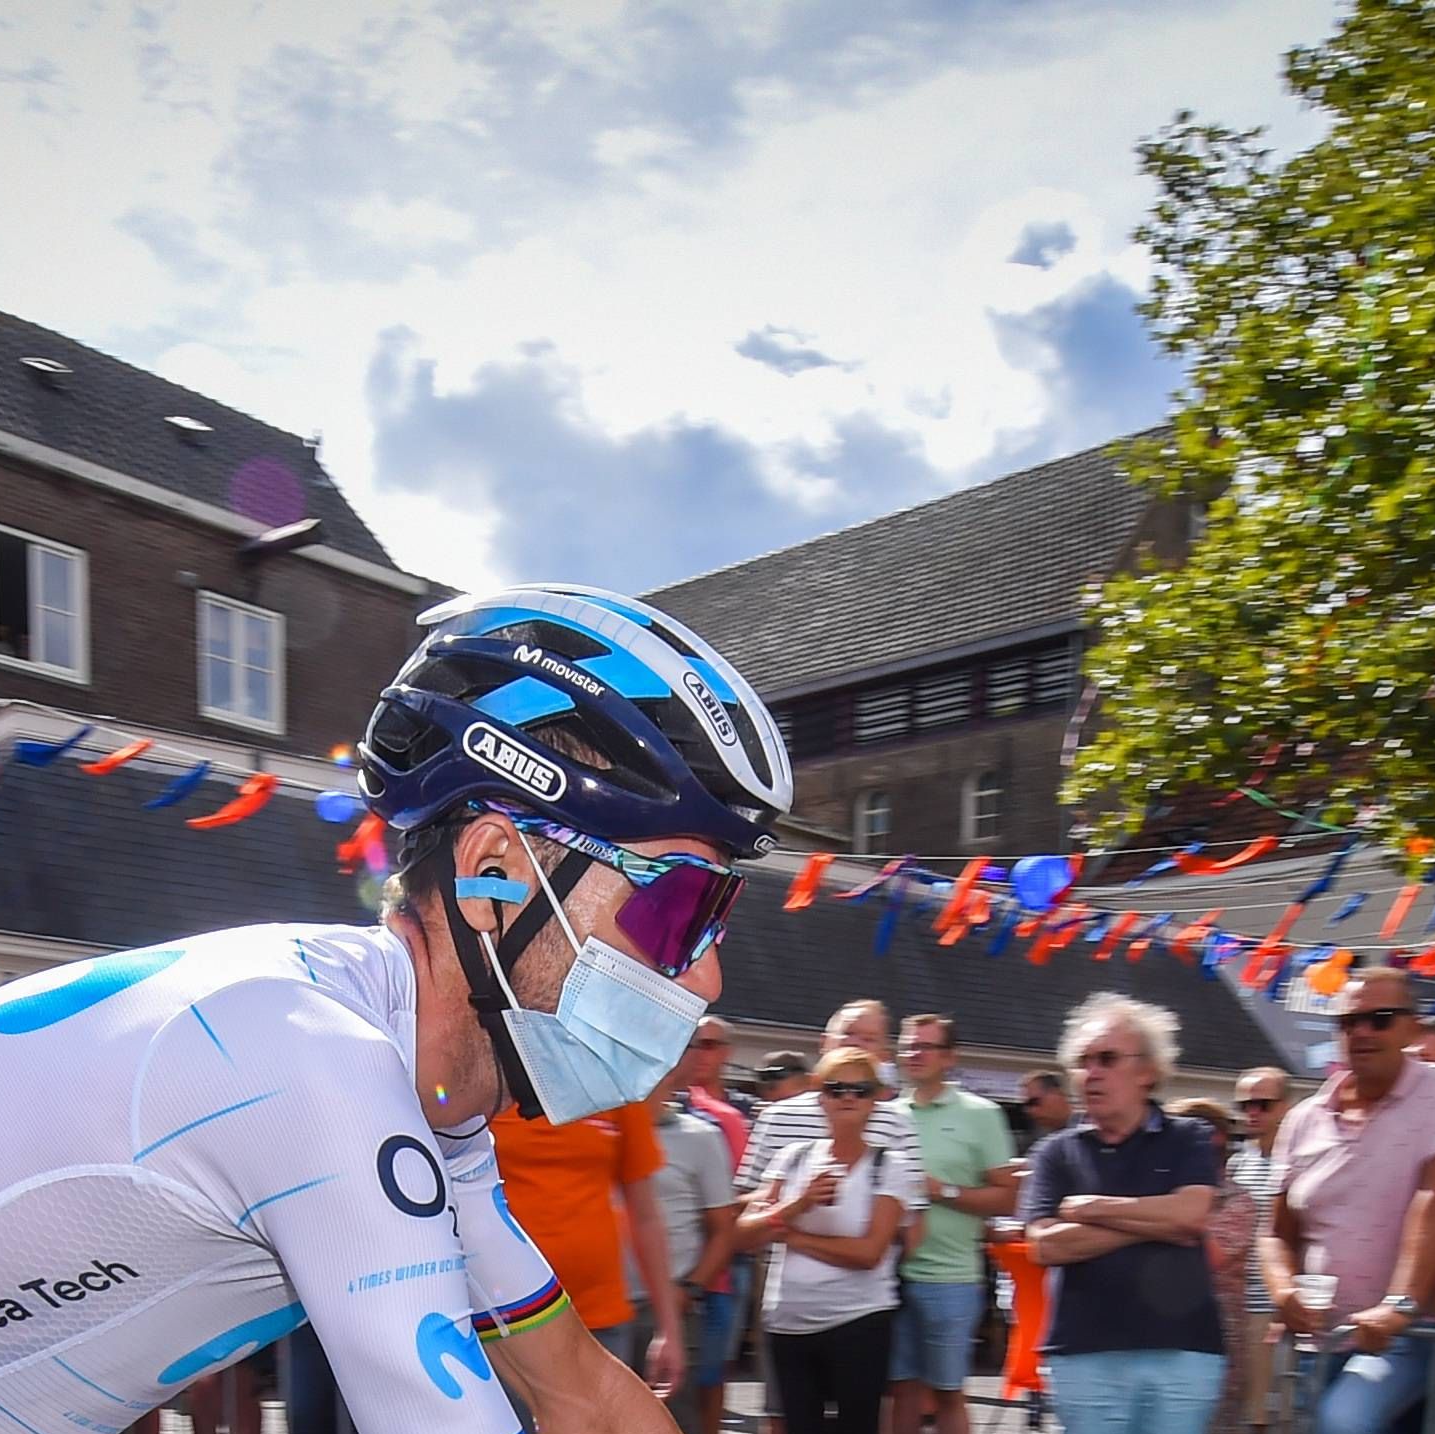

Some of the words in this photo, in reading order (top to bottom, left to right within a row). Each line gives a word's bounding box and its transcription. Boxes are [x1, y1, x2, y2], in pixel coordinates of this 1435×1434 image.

[541, 657, 605, 697] movistar
[691, 682, 732, 739] ABUS
[473, 732, 555, 792] ABUS
[19, 1259, 140, 1309] Tech
[358, 1270, 392, 1292] TIMES
[395, 1261, 437, 1281] WINNER
